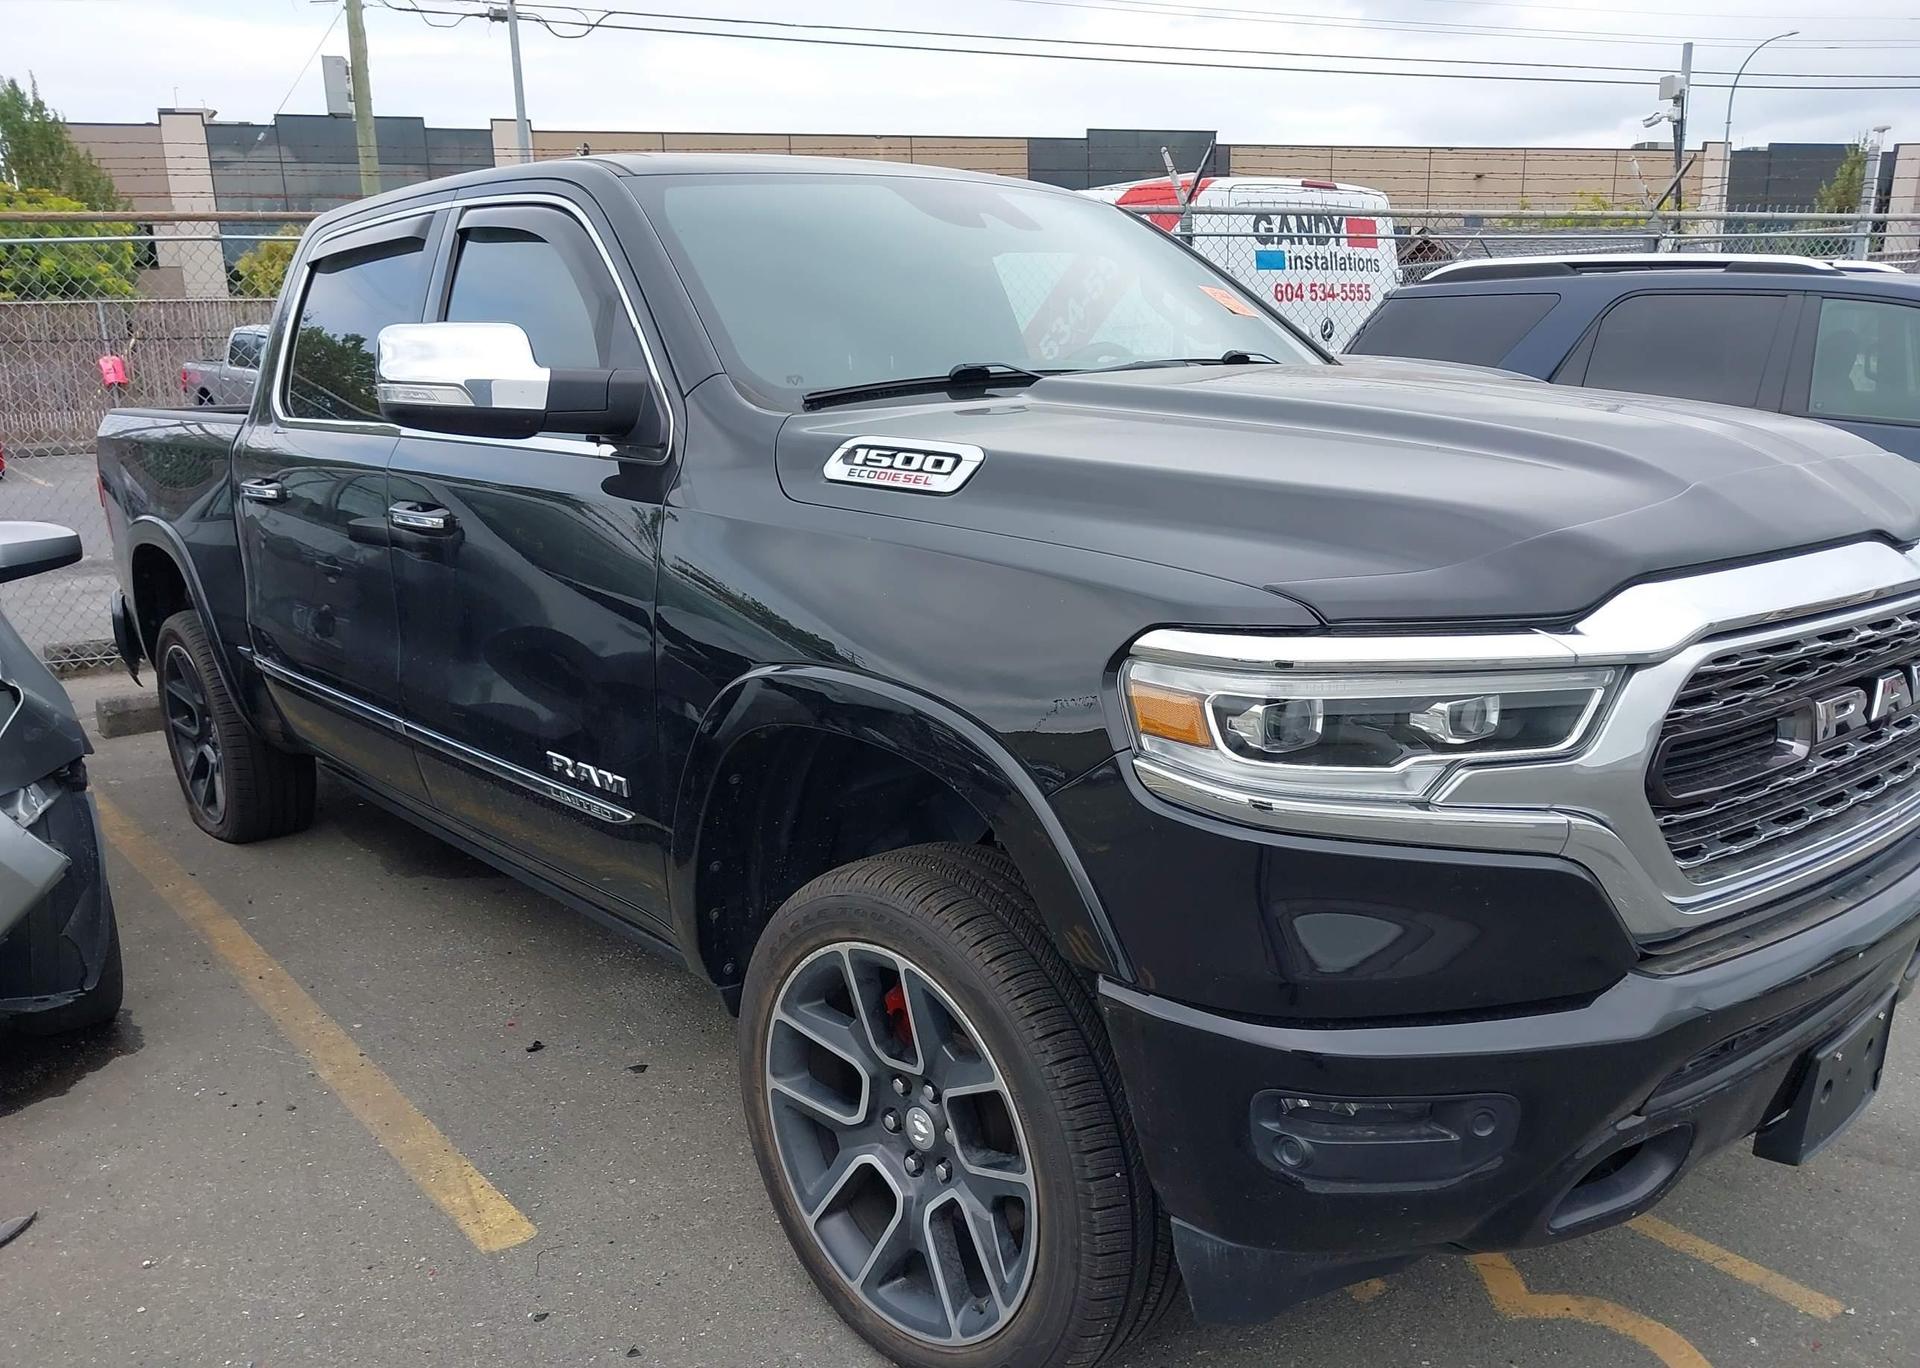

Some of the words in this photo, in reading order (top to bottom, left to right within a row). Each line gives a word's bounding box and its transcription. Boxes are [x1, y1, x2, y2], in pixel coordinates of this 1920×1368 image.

[1252, 213, 1344, 247] GANDY
[1288, 250, 1380, 273] installations
[1274, 283, 1304, 302] 604
[1309, 282, 1371, 302] 534-5555
[852, 448, 956, 474] 1500
[847, 468, 932, 486] ECODIESEL
[1815, 660, 1920, 744] RA
[546, 750, 632, 798] RAM
